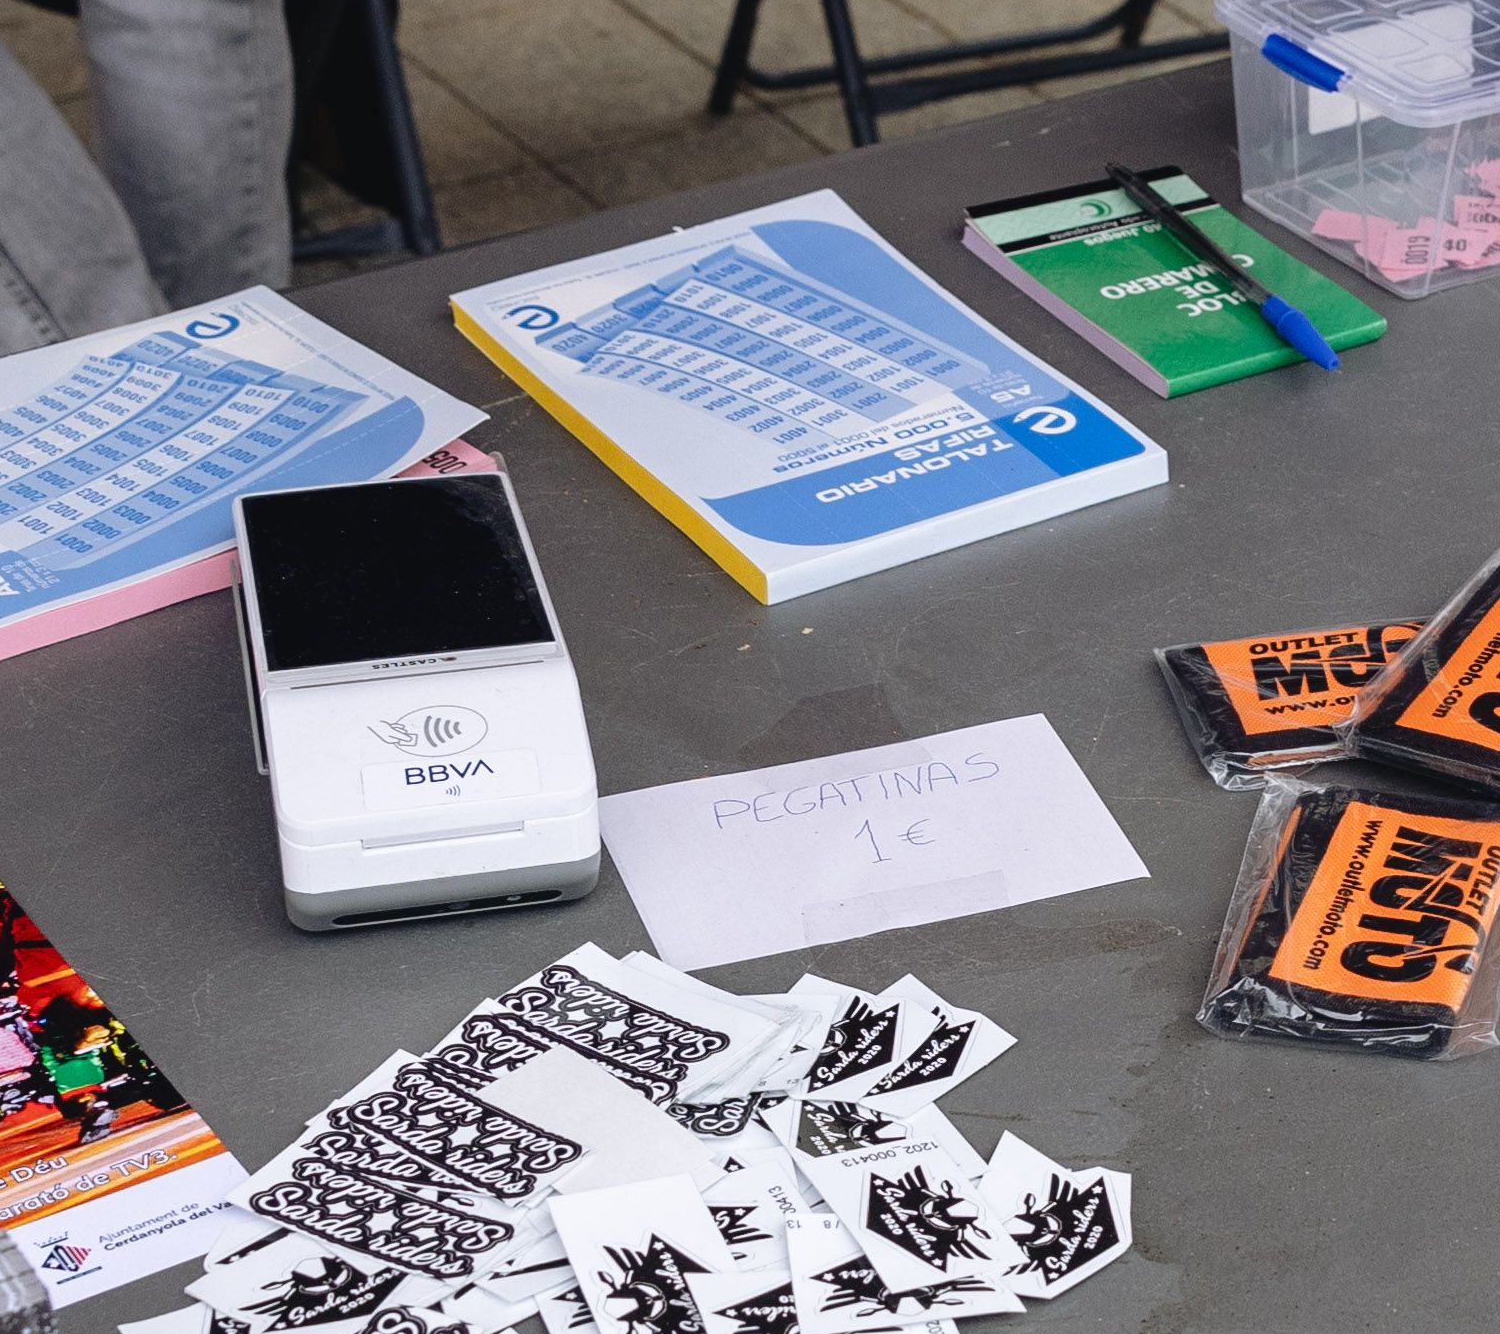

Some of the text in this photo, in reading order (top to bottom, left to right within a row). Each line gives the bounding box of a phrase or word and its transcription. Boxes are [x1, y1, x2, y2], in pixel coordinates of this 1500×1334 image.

[1078, 224, 1139, 246] Juegos
[1099, 253, 1255, 300] CMARERO
[1174, 280, 1219, 300] DE
[771, 412, 976, 473] 5.000 Números
[893, 425, 996, 461] RIFAS
[815, 439, 1014, 503] TALONARIO
[371, 657, 437, 670] CASTLES
[1249, 631, 1360, 658] OUTLET
[404, 758, 495, 786] BBVA
[712, 752, 1001, 830] PEGATINAS
[853, 817, 938, 865] 1 €
[1339, 826, 1484, 983] MOTO
[817, 1019, 889, 1082] Sarda riders
[354, 1096, 529, 1195] Sarda riders
[10, 1153, 69, 1184] Déu
[99, 1201, 200, 1244] Ajuntament de
[104, 1207, 213, 1251] Cerdanyola del
[255, 1185, 467, 1277] Sarda riders
